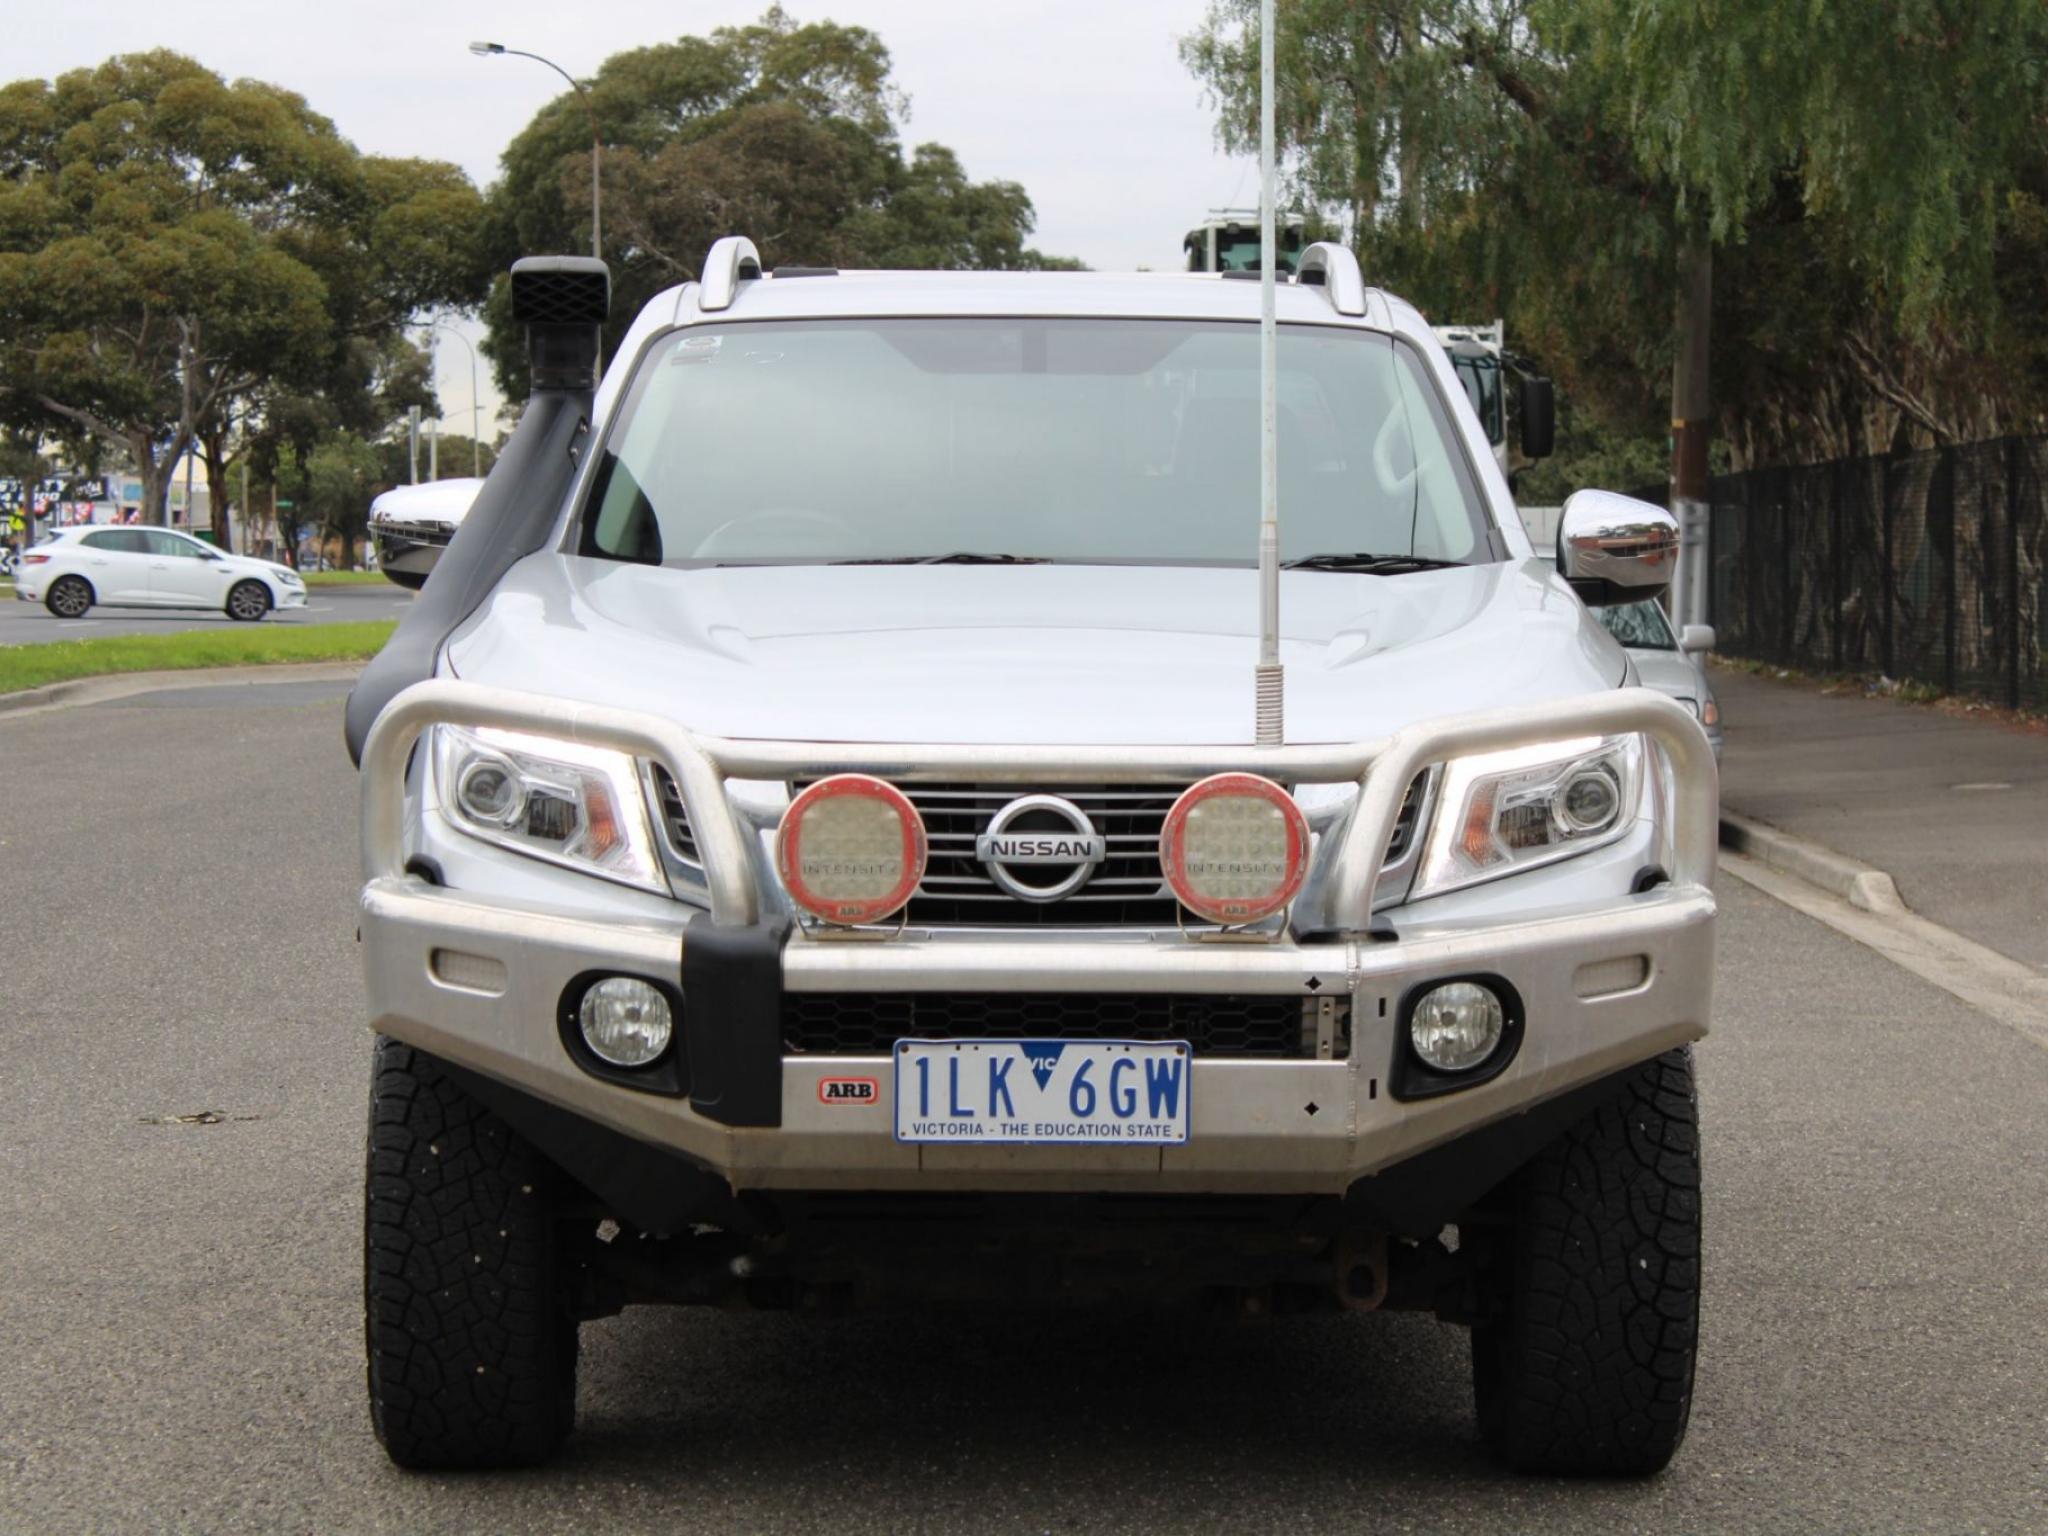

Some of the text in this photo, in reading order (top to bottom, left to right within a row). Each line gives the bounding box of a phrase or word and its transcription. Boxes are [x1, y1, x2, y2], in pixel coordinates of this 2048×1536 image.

[991, 841, 1091, 856] NISSAN
[1187, 863, 1281, 873] INTENSITY
[1027, 1058, 1057, 1071] VIC
[827, 1083, 872, 1097] ARB
[913, 1123, 984, 1135] VICTORIA
[1001, 1123, 1029, 1136] THE
[1035, 1123, 1121, 1136] EDUCATION
[1127, 1124, 1172, 1137] STATE
